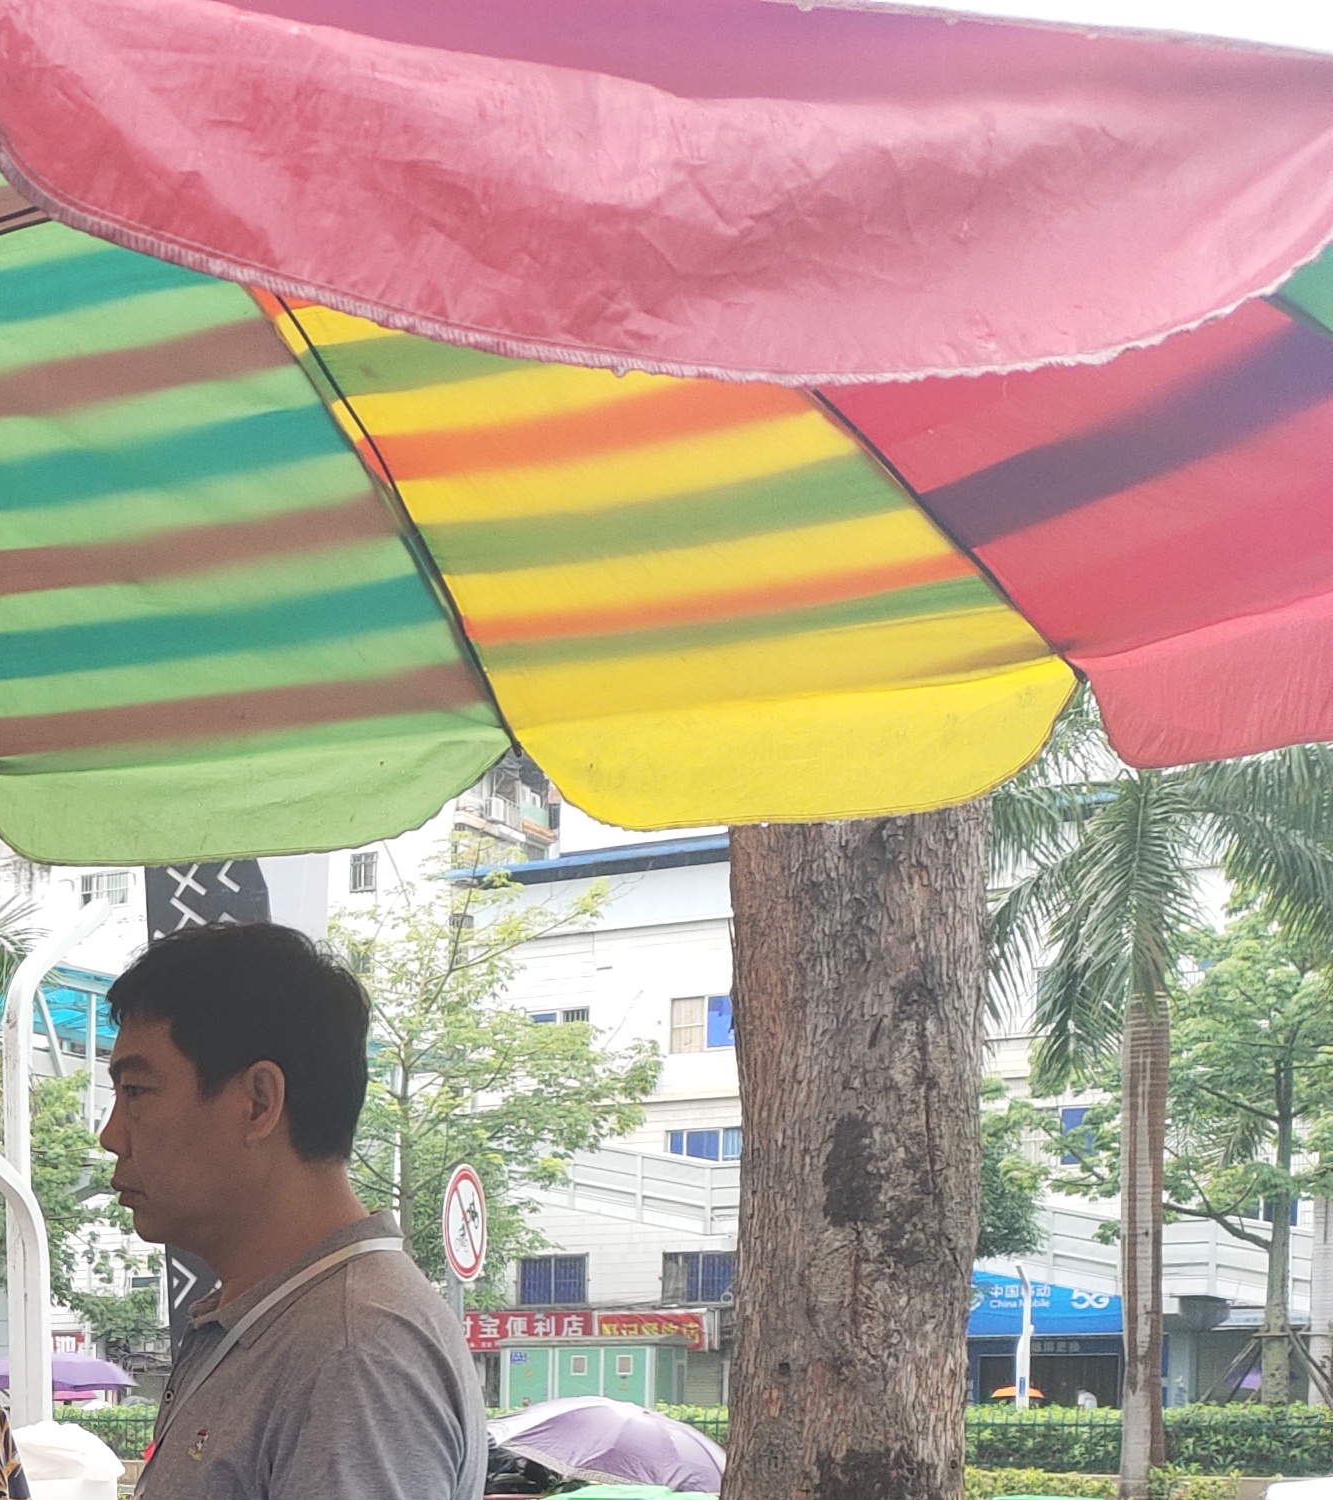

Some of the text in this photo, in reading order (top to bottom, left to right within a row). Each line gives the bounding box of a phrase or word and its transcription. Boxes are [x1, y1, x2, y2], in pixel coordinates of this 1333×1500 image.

[989, 1299, 1050, 1308] China bile
[1070, 1290, 1110, 1309] 5G
